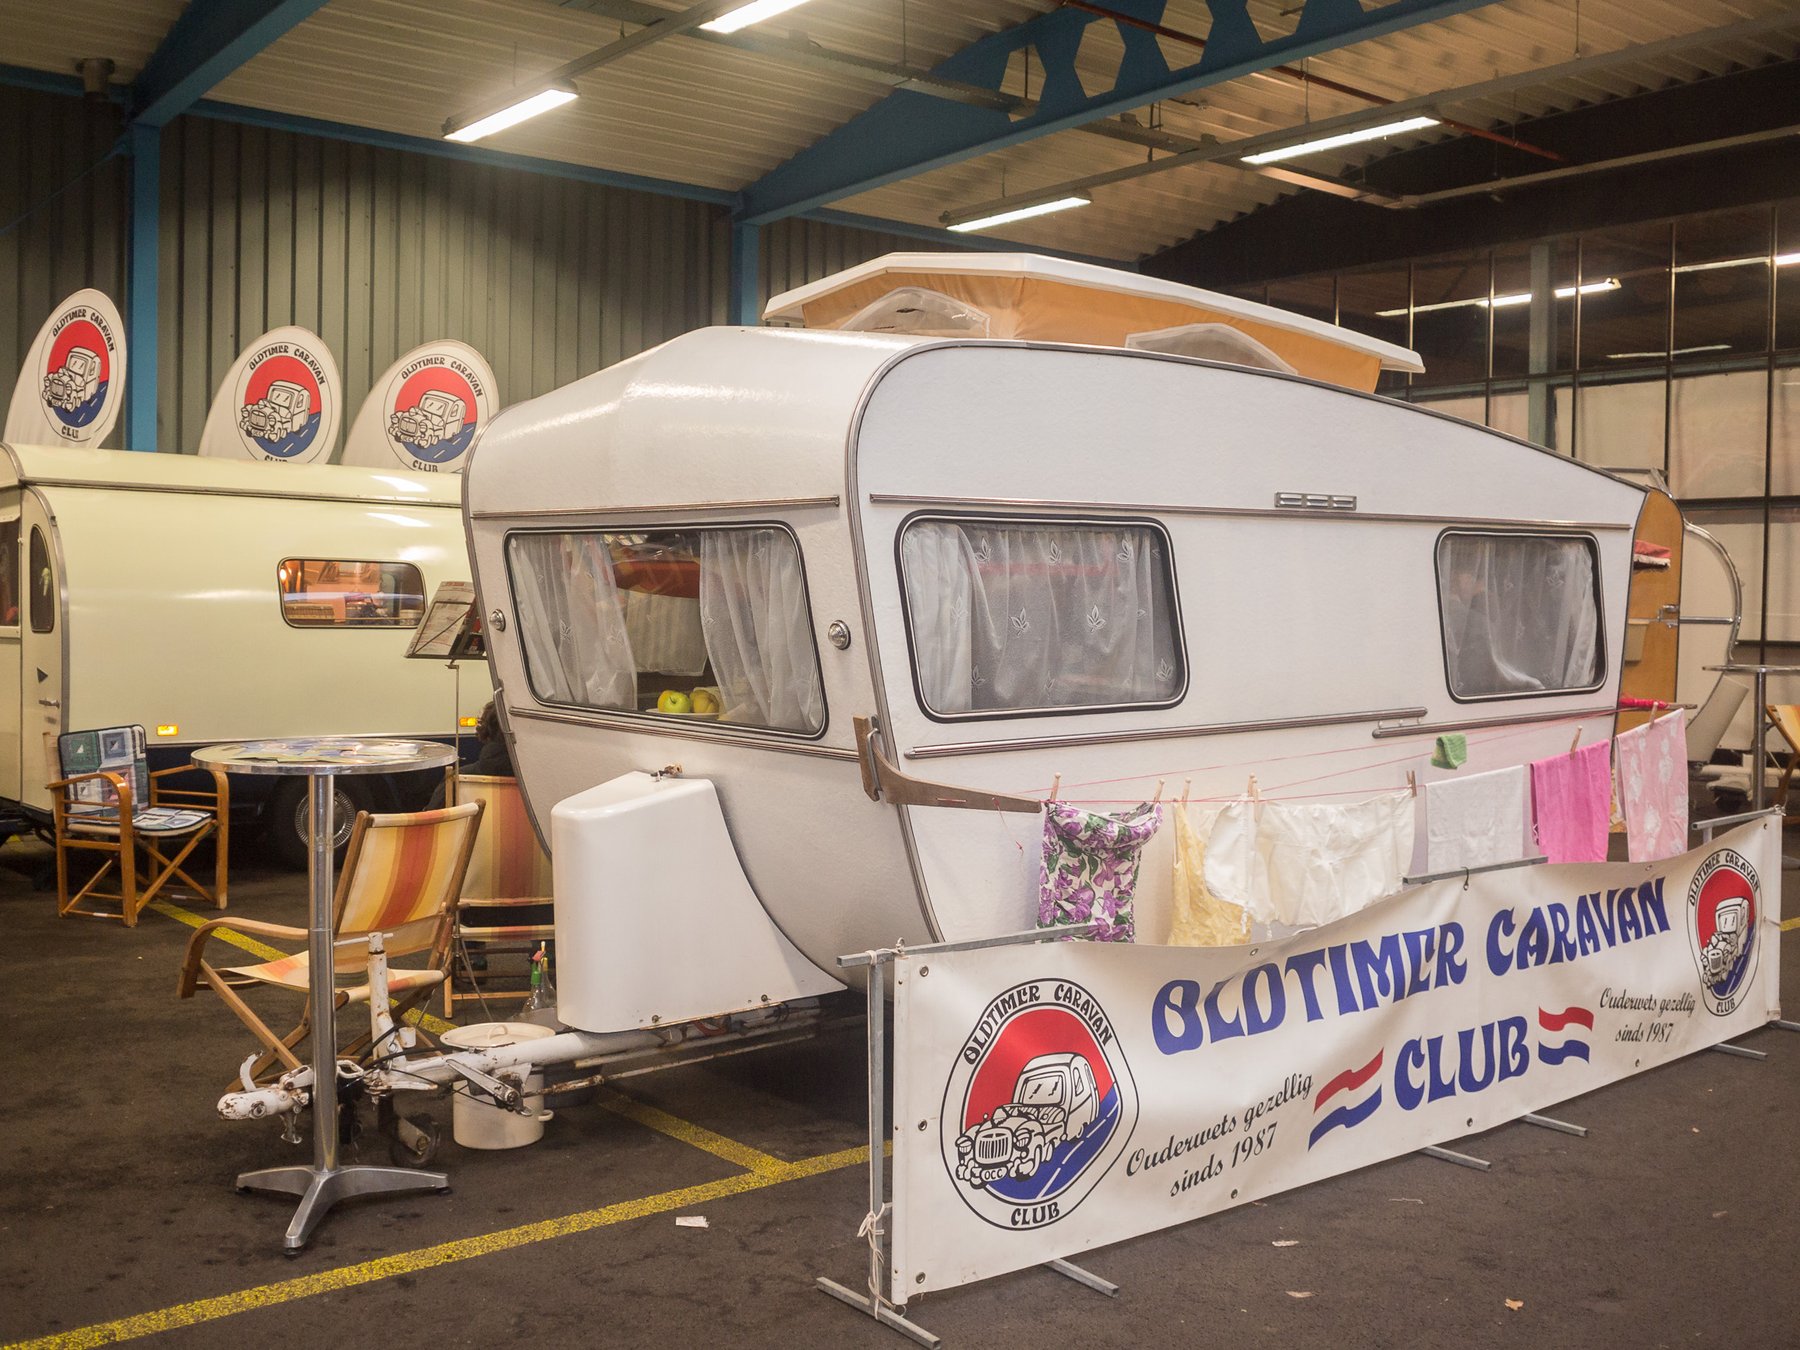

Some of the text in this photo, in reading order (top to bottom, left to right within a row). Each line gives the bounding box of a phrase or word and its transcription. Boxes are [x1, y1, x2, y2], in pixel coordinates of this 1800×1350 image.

[52, 308, 115, 352] OLDTIMER CARAVAN
[249, 345, 326, 385] OLDTIMER CARAVAN
[401, 357, 484, 397] OLDTIMER CARAVAN
[61, 425, 79, 439] CLU
[1689, 852, 1760, 907] OLDTIMER CARAVAN
[1151, 876, 1673, 1056] OLDTIMER CARAVAN
[1600, 987, 1696, 1018] Ouderwets gezellig
[1716, 997, 1736, 1013] CLUB
[963, 983, 1113, 1065] OLDTIMER CARAVAN
[1615, 1022, 1674, 1043] sinds 1987
[1393, 1015, 1531, 1111] CLUB
[1126, 1073, 1313, 1177] Ouderwets gezellig
[984, 1168, 1003, 1180] OCC
[1170, 1121, 1278, 1198] sinds 1987
[1011, 1201, 1060, 1227] CLUB
